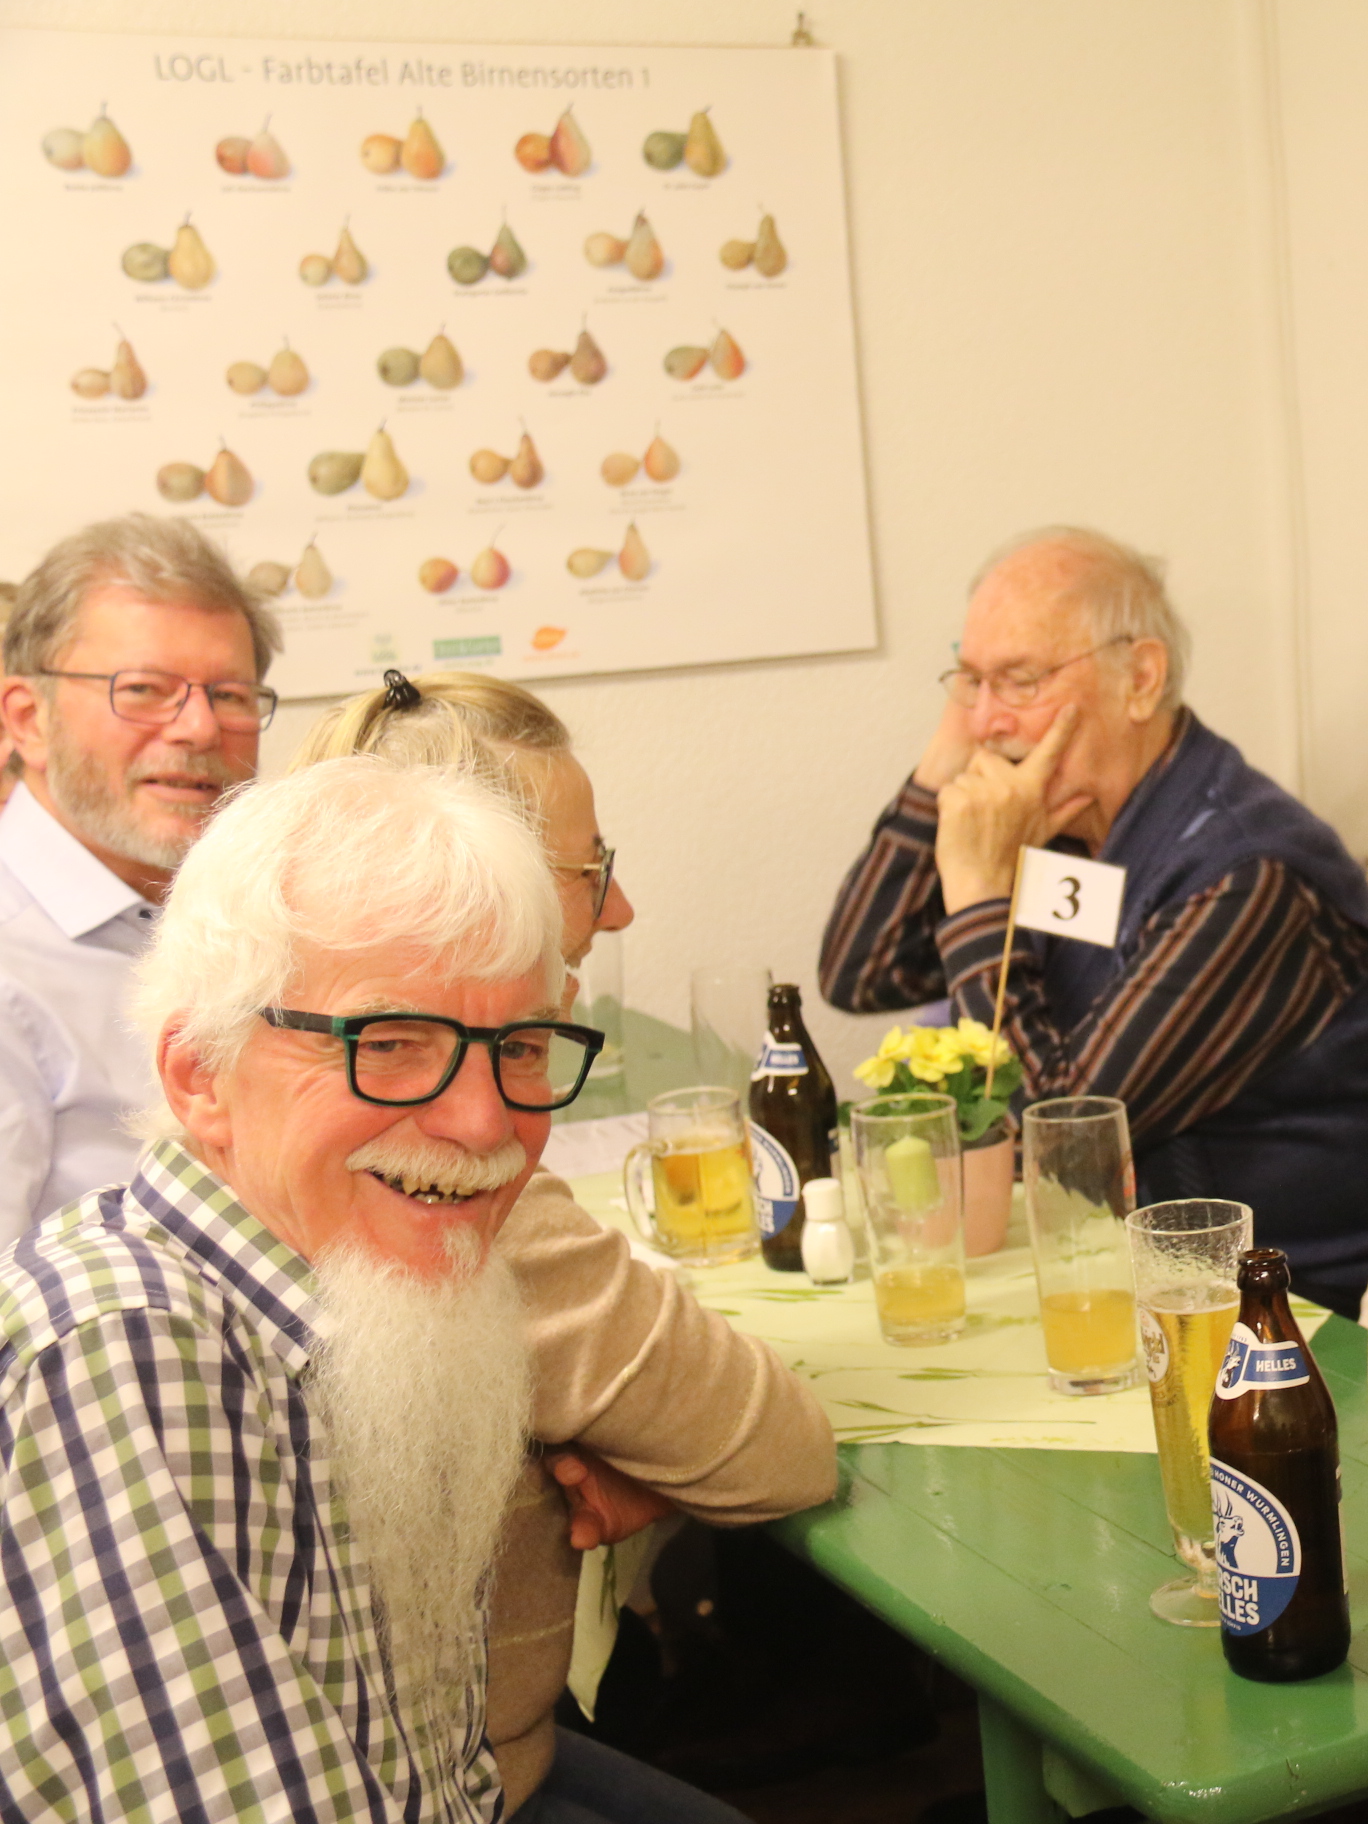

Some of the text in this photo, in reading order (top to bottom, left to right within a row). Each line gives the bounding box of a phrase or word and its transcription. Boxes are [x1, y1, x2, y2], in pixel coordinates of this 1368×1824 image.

[154, 54, 235, 83] LOGL
[262, 55, 389, 86] Farbtafel
[399, 57, 454, 88] Alte
[460, 61, 634, 89] Birnensorten
[641, 67, 651, 88] 1
[1052, 876, 1081, 921] 3
[1256, 1358, 1296, 1372] HELLES
[1246, 1491, 1290, 1567] WURMLINGEN
